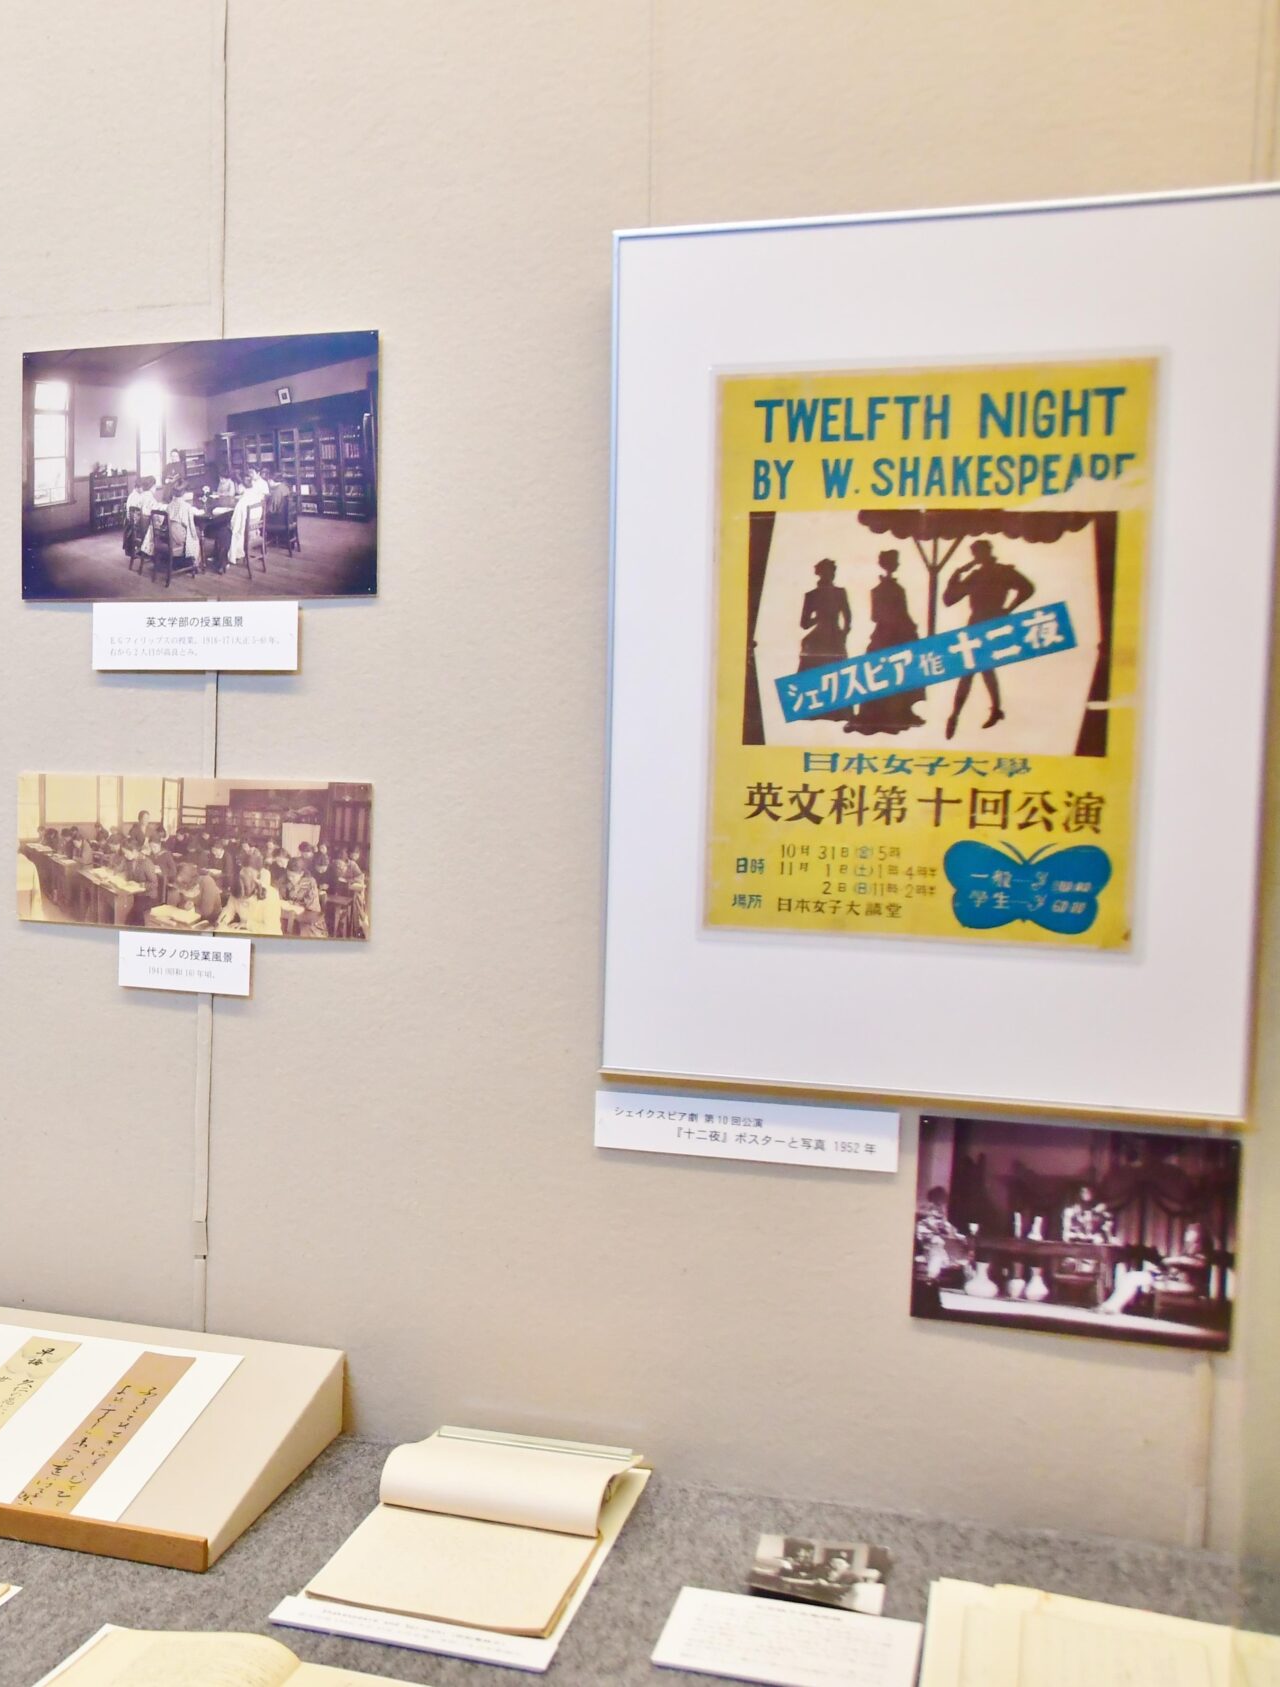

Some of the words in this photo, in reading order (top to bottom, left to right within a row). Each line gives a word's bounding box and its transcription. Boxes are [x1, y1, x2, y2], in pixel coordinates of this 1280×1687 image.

[754, 394, 950, 444] TWELFTH
[979, 387, 1127, 438] NIGHT
[753, 459, 794, 500] BY
[822, 458, 860, 497] W.
[146, 616, 244, 628] 英文学部の授業風景
[803, 751, 1032, 777] 日本女子大學
[744, 782, 1106, 835] 英文科第十回公演
[736, 856, 765, 875] 日時
[732, 893, 763, 909] 場所
[136, 946, 233, 964] 上代タノの授業風景
[614, 1106, 698, 1123] シェイクスピア劇
